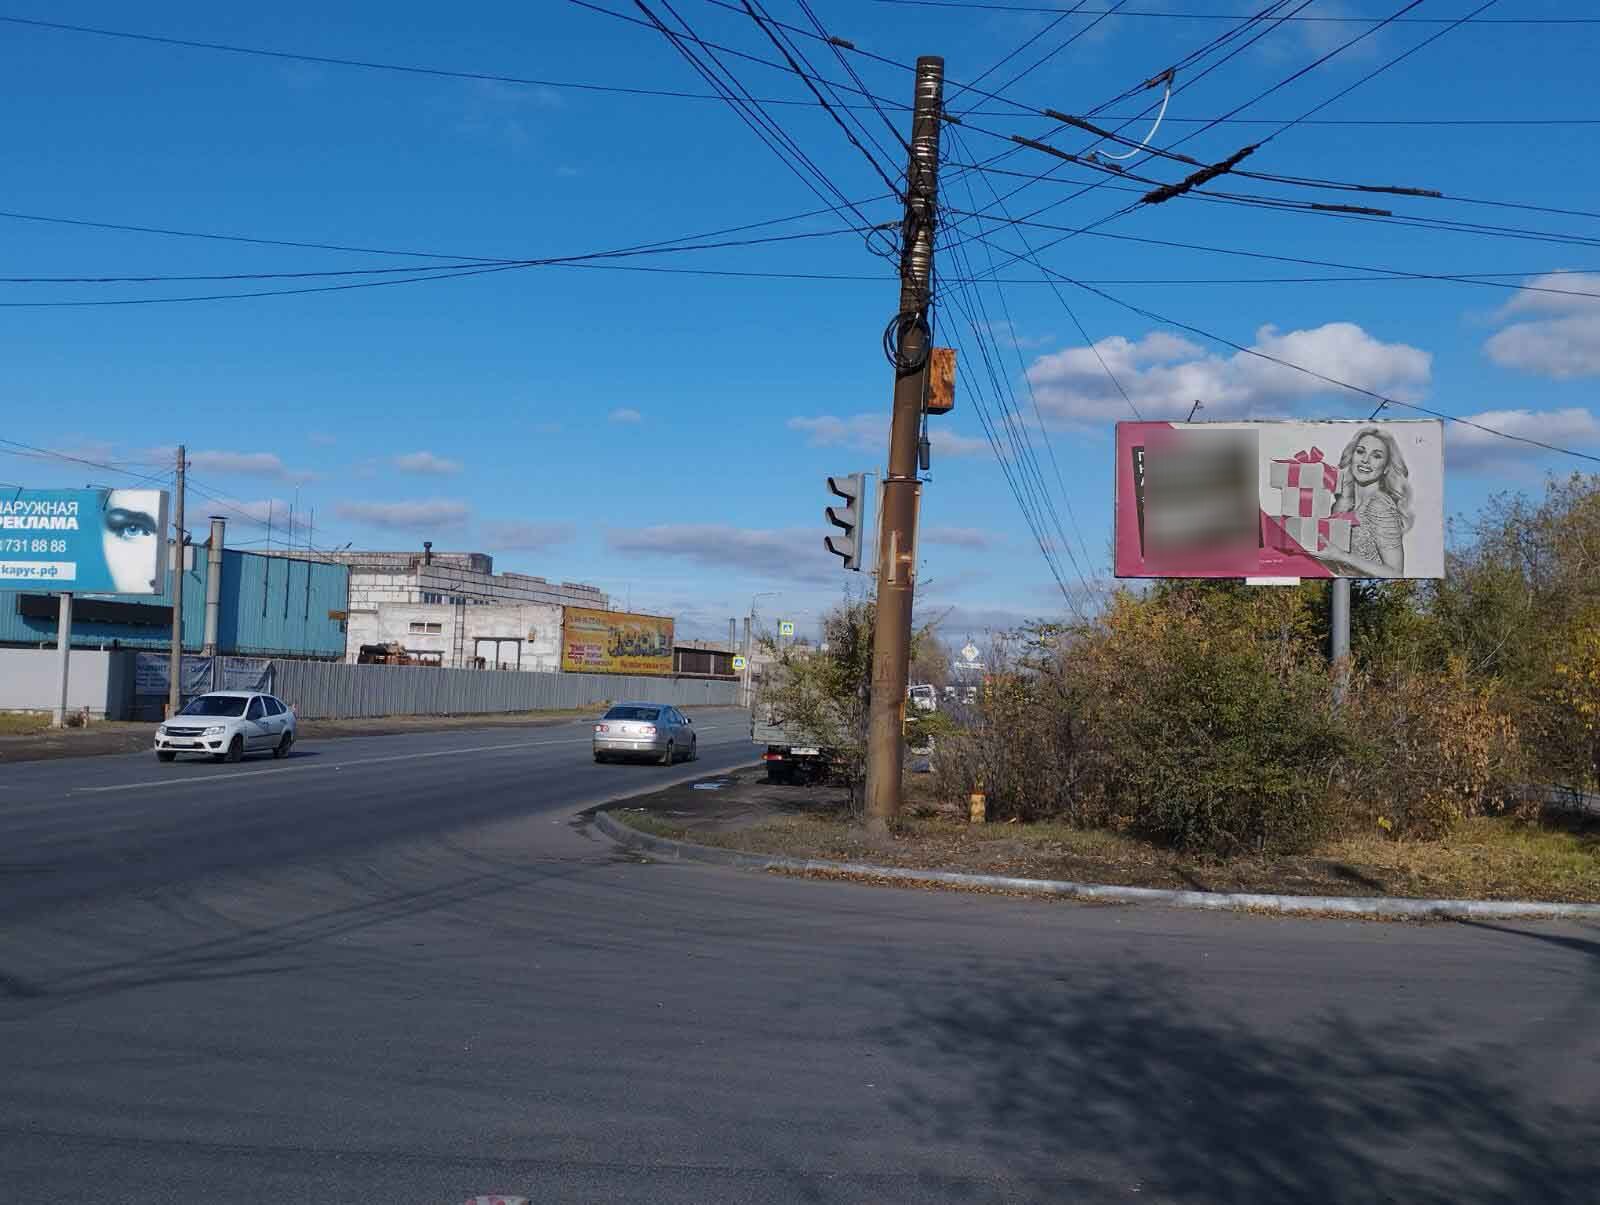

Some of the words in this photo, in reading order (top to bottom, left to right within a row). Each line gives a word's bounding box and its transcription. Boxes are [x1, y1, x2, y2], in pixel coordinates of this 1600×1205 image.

[0, 501, 78, 515] АРУЖНАЯ
[6, 539, 28, 552] 731
[31, 540, 48, 552] 88
[50, 540, 66, 553] 88
